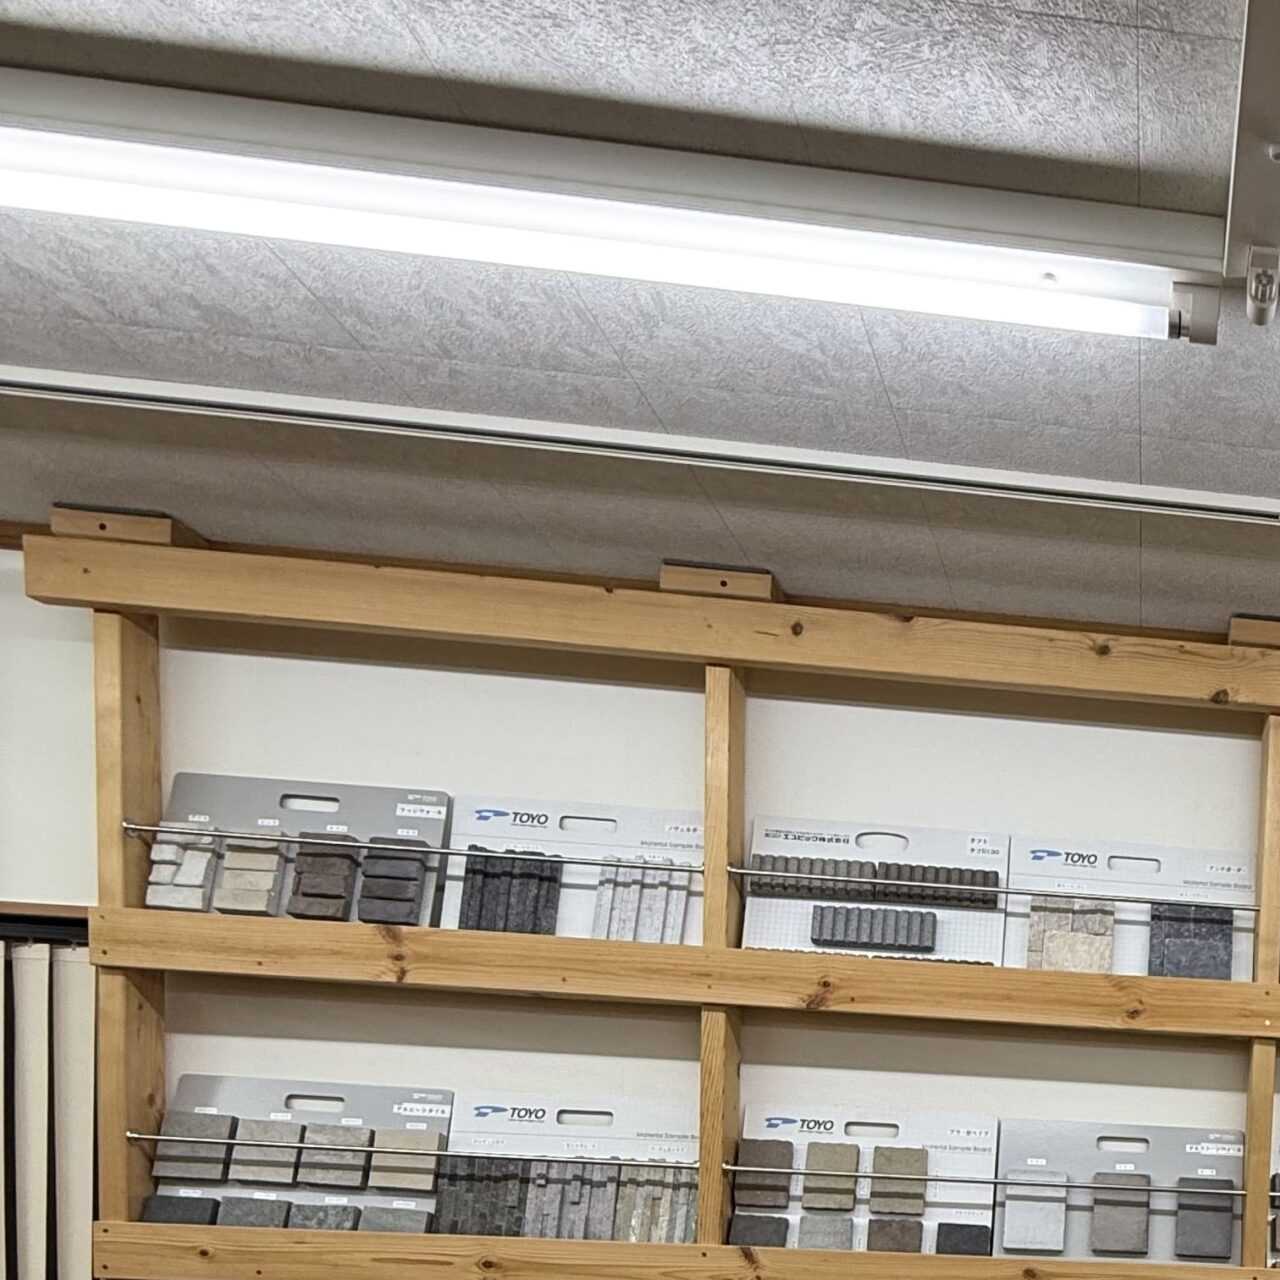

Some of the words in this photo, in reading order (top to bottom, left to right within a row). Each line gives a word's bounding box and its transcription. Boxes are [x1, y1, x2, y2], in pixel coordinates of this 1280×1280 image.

[512, 812, 549, 825] TOYO
[1062, 852, 1097, 865] TOYO
[510, 1107, 547, 1120] TOYO
[799, 1119, 834, 1131] TOYO
